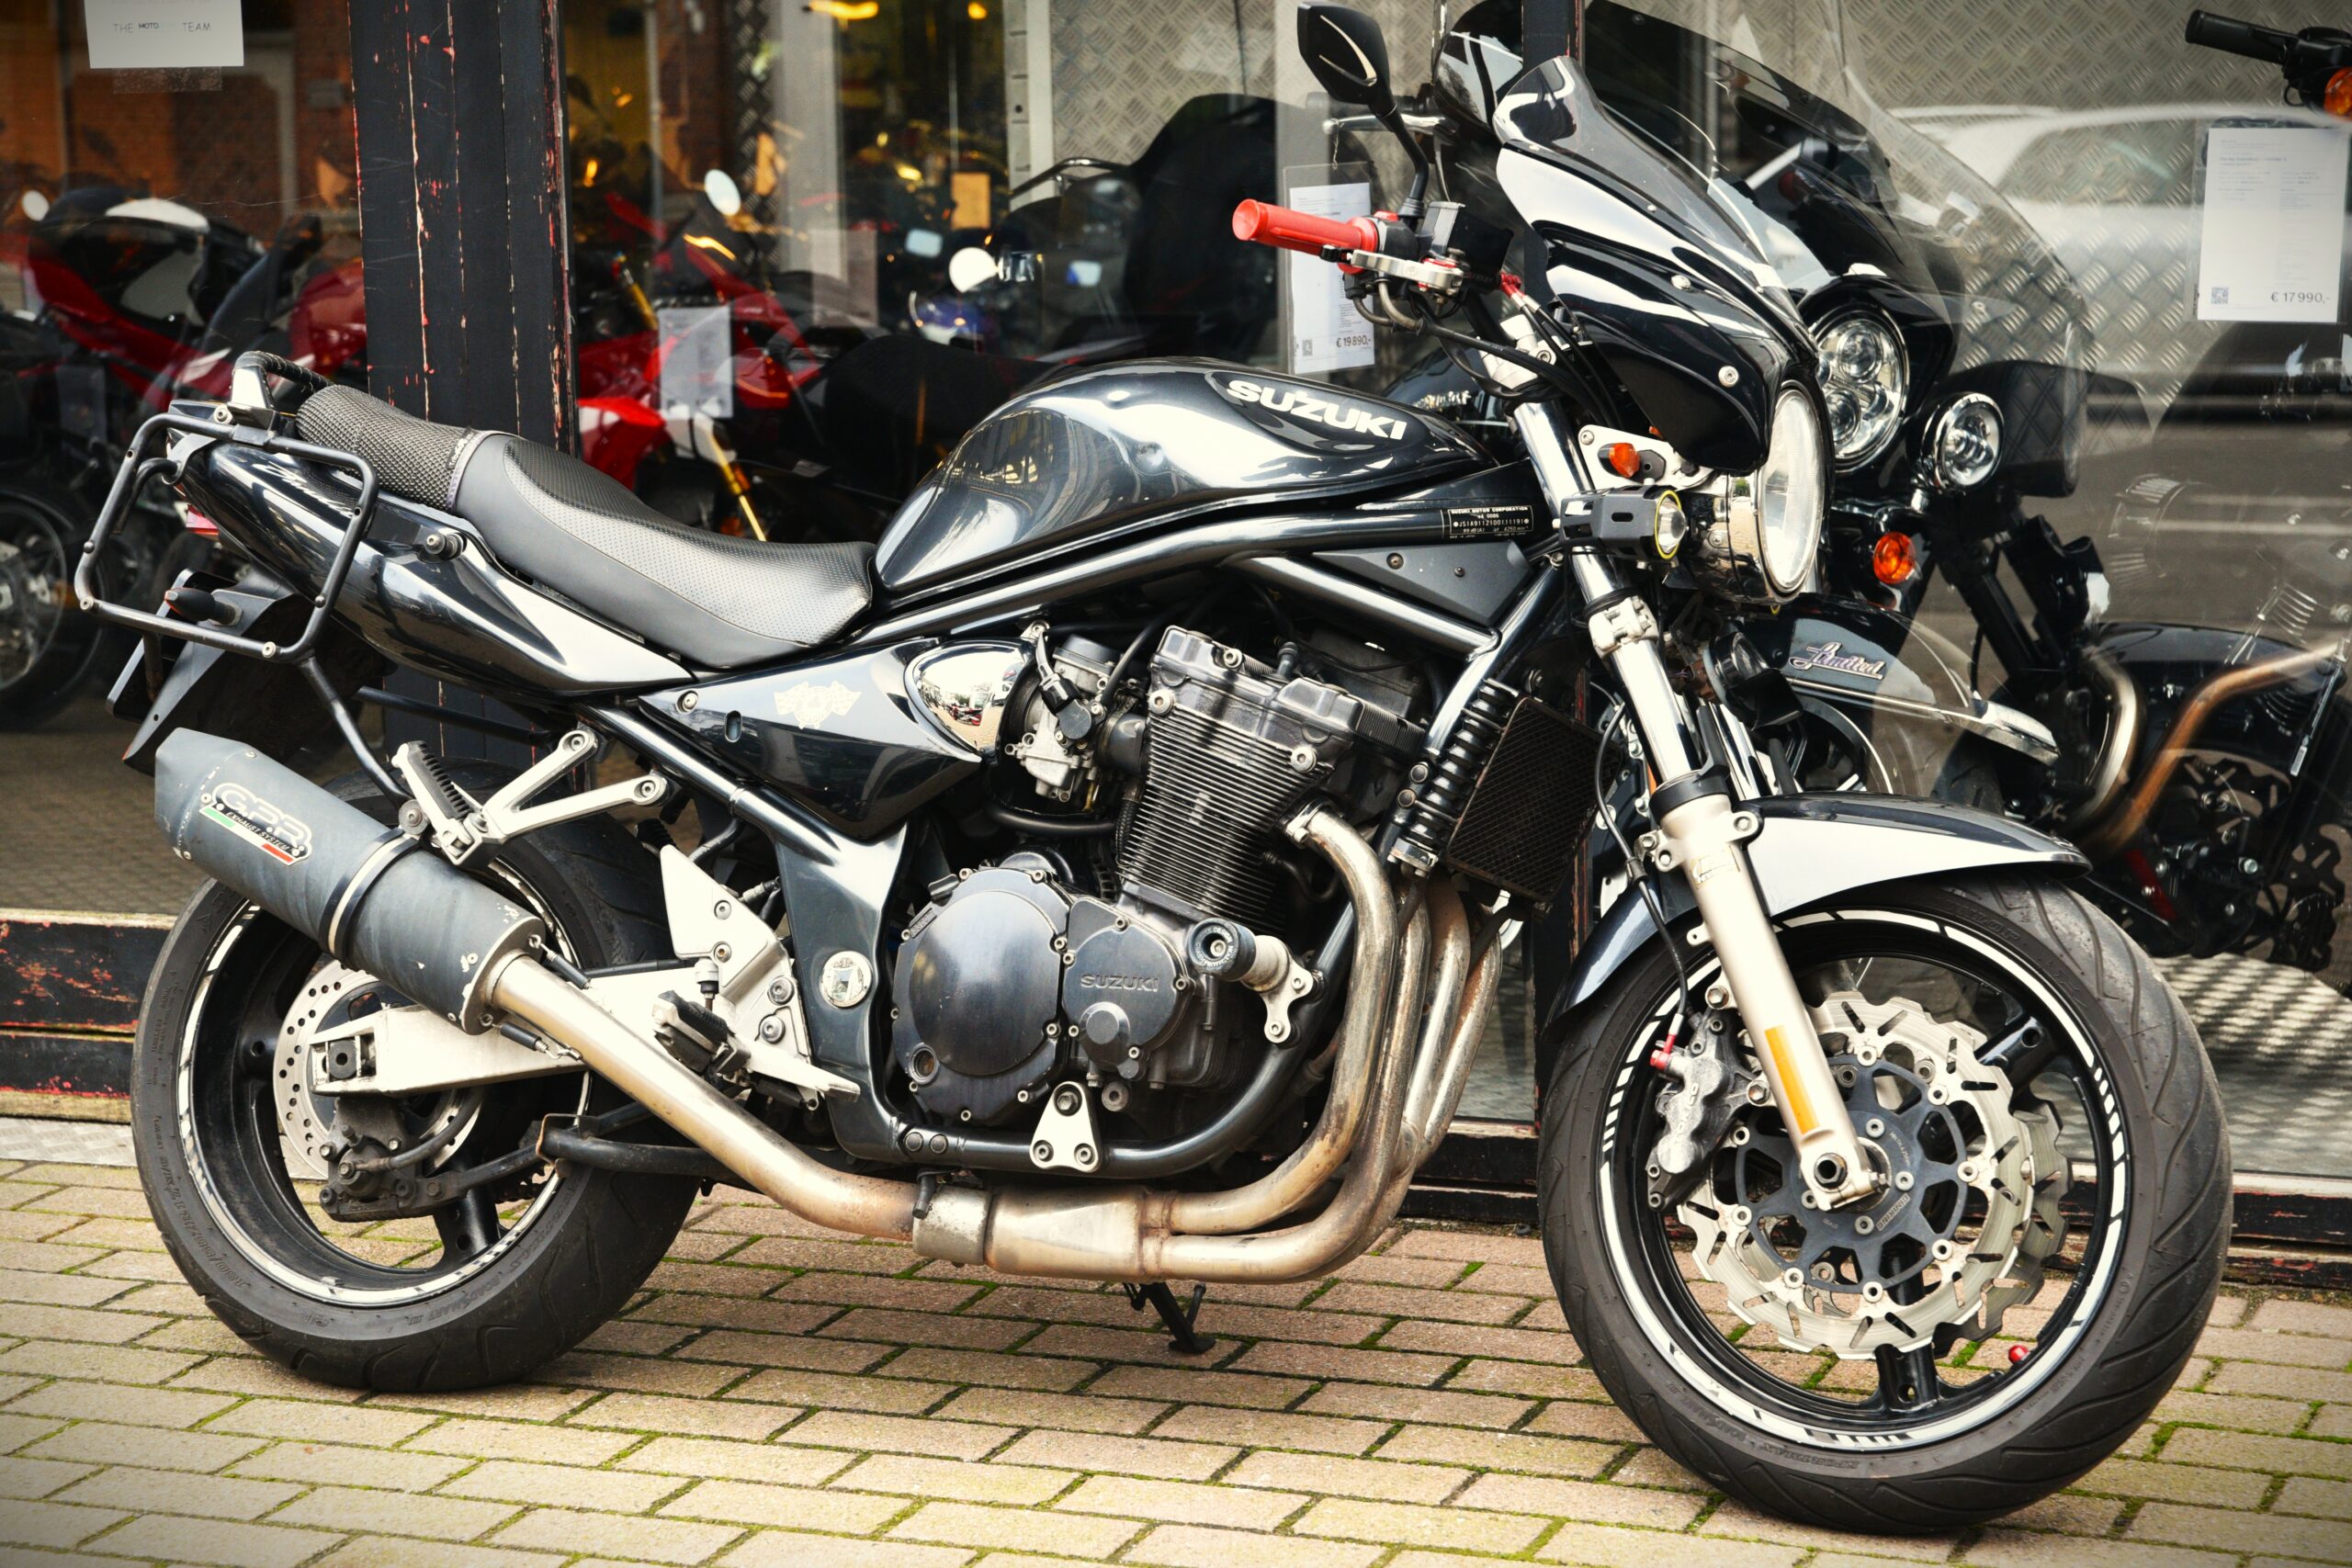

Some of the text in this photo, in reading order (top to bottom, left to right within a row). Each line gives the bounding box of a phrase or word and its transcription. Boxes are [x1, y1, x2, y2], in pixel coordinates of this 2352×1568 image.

[113, 22, 133, 33] THE
[182, 22, 210, 32] TEAM
[1227, 379, 1408, 441] SUZUKI
[1789, 642, 1885, 680] Limited
[226, 811, 289, 851] EXHAUST SYSTEM
[1080, 974, 1159, 992] SUZUKI
